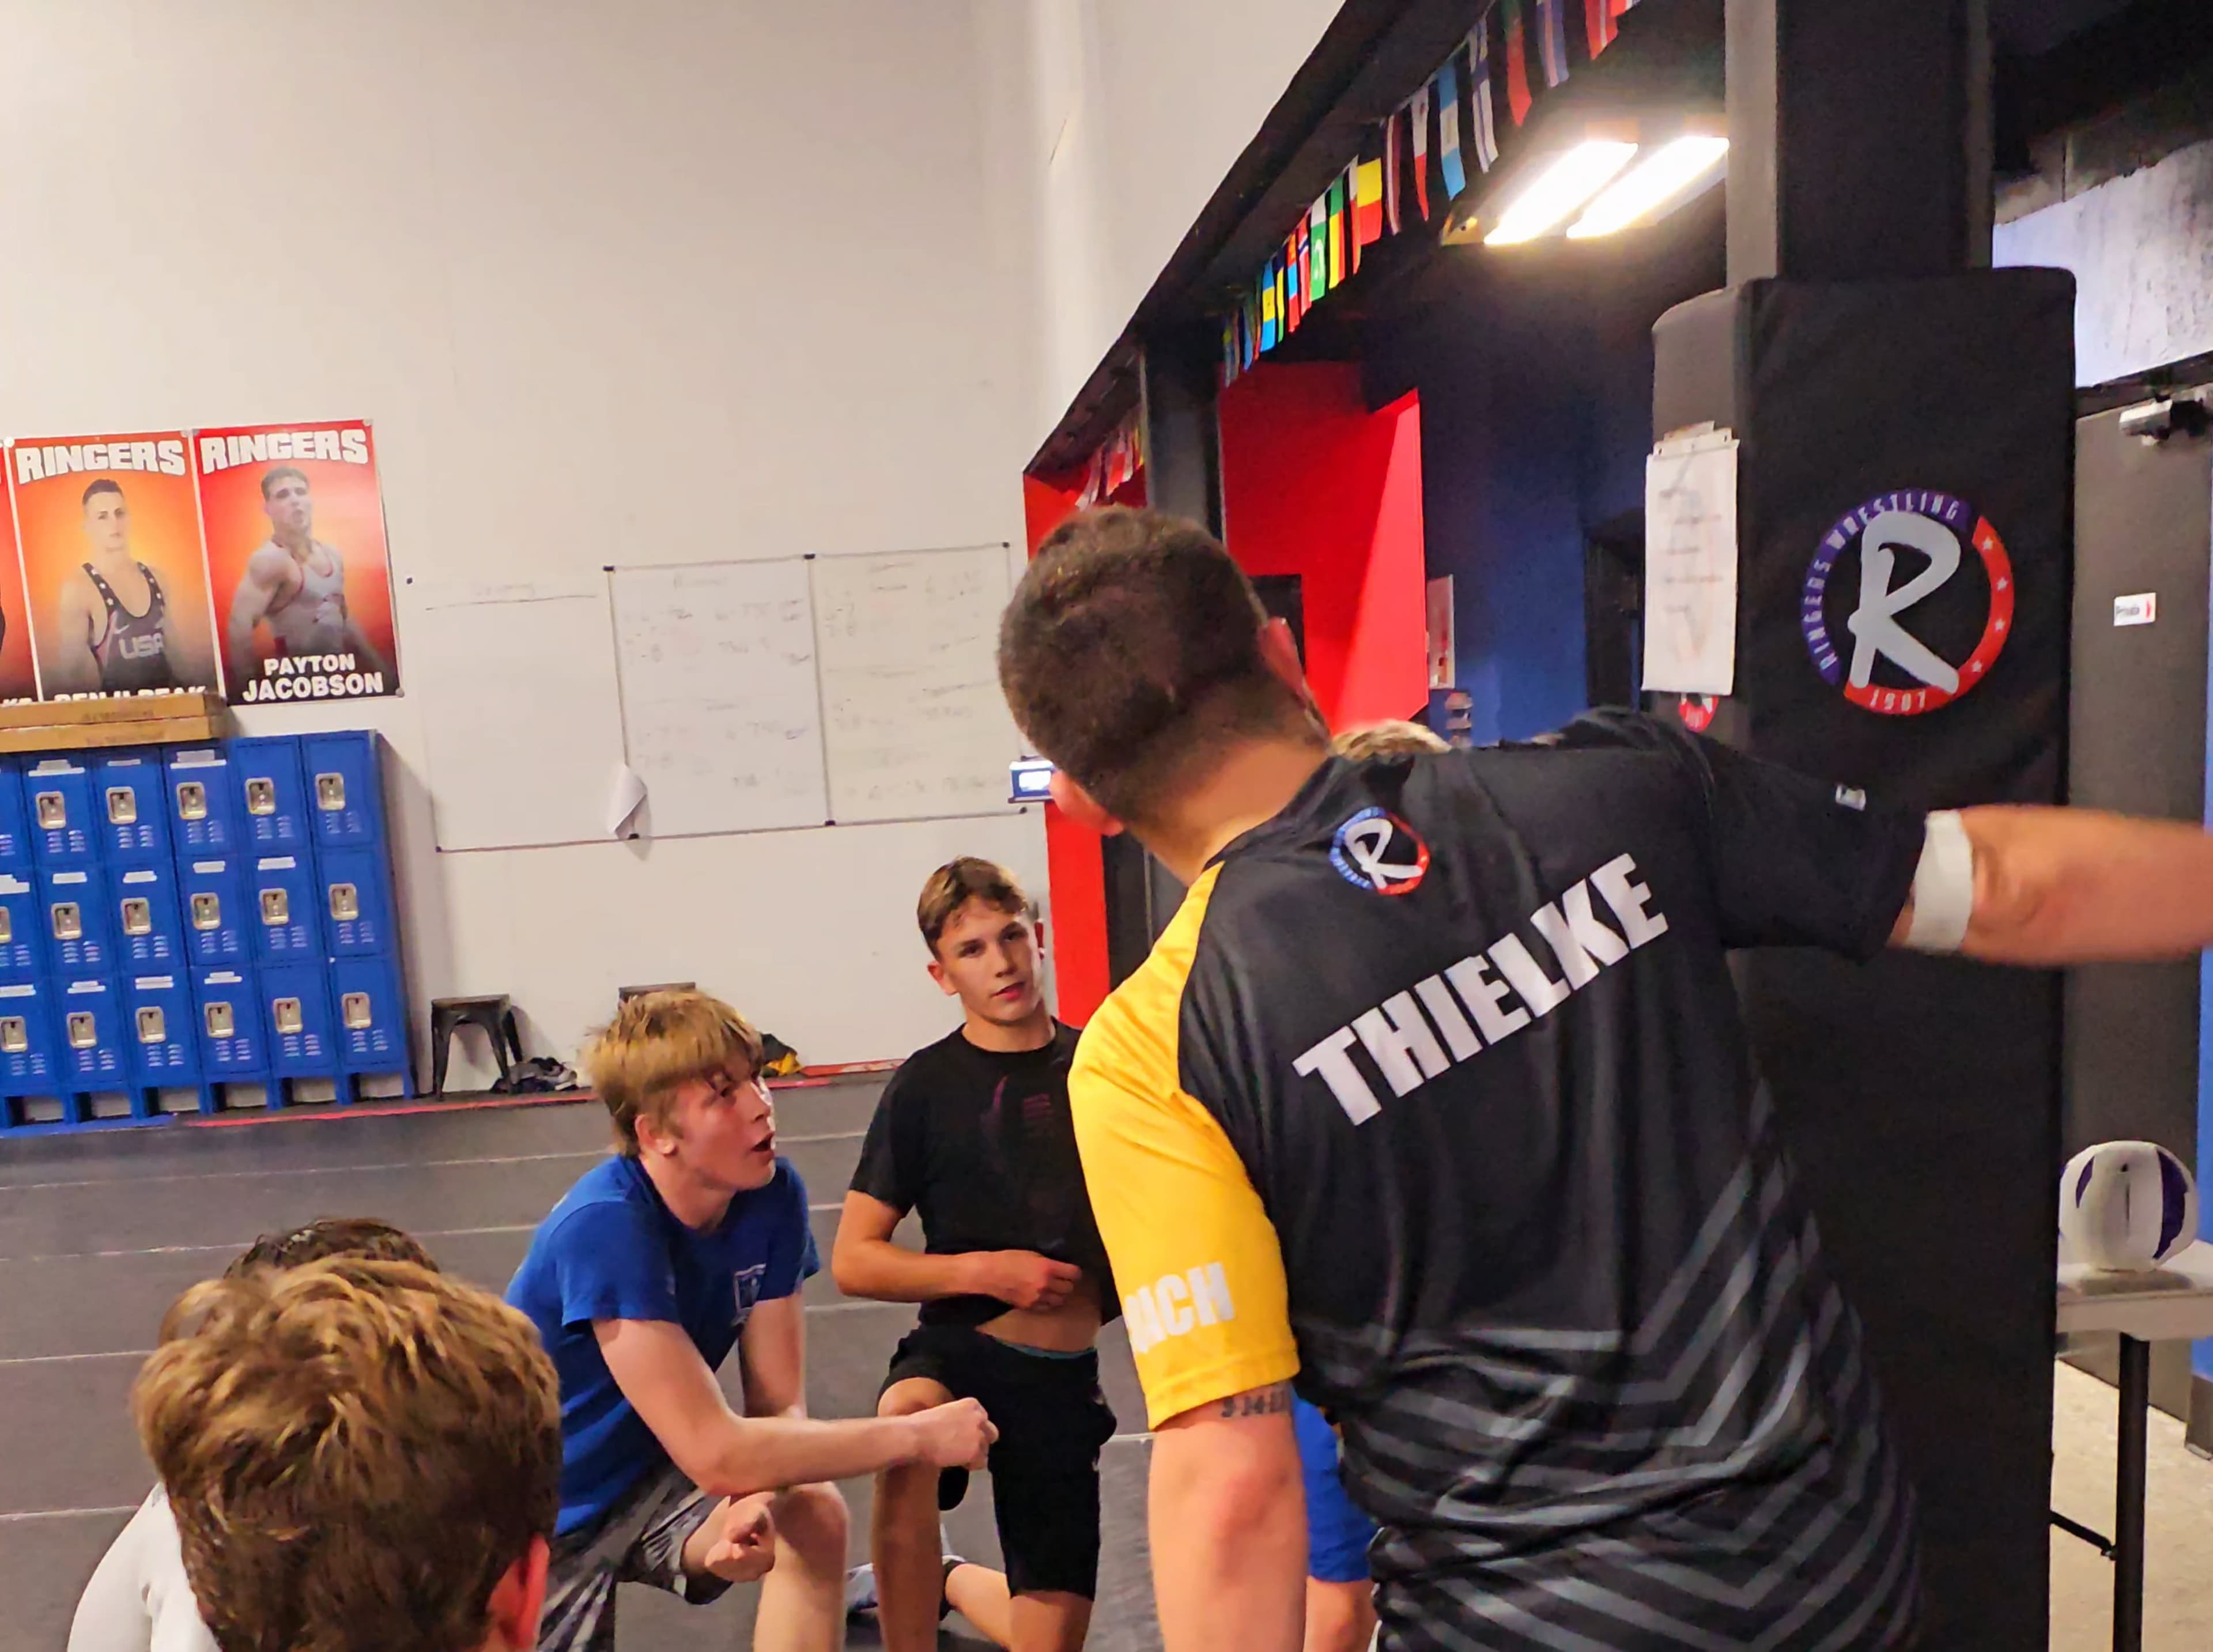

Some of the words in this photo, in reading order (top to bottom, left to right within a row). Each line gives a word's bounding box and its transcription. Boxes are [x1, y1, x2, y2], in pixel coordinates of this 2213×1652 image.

[15, 440, 187, 485] RINGERS
[199, 429, 368, 474] RINGERS
[242, 671, 383, 702] JACOBSON
[263, 653, 356, 676] PAYTON
[1291, 853, 1668, 1126] THIELKE
